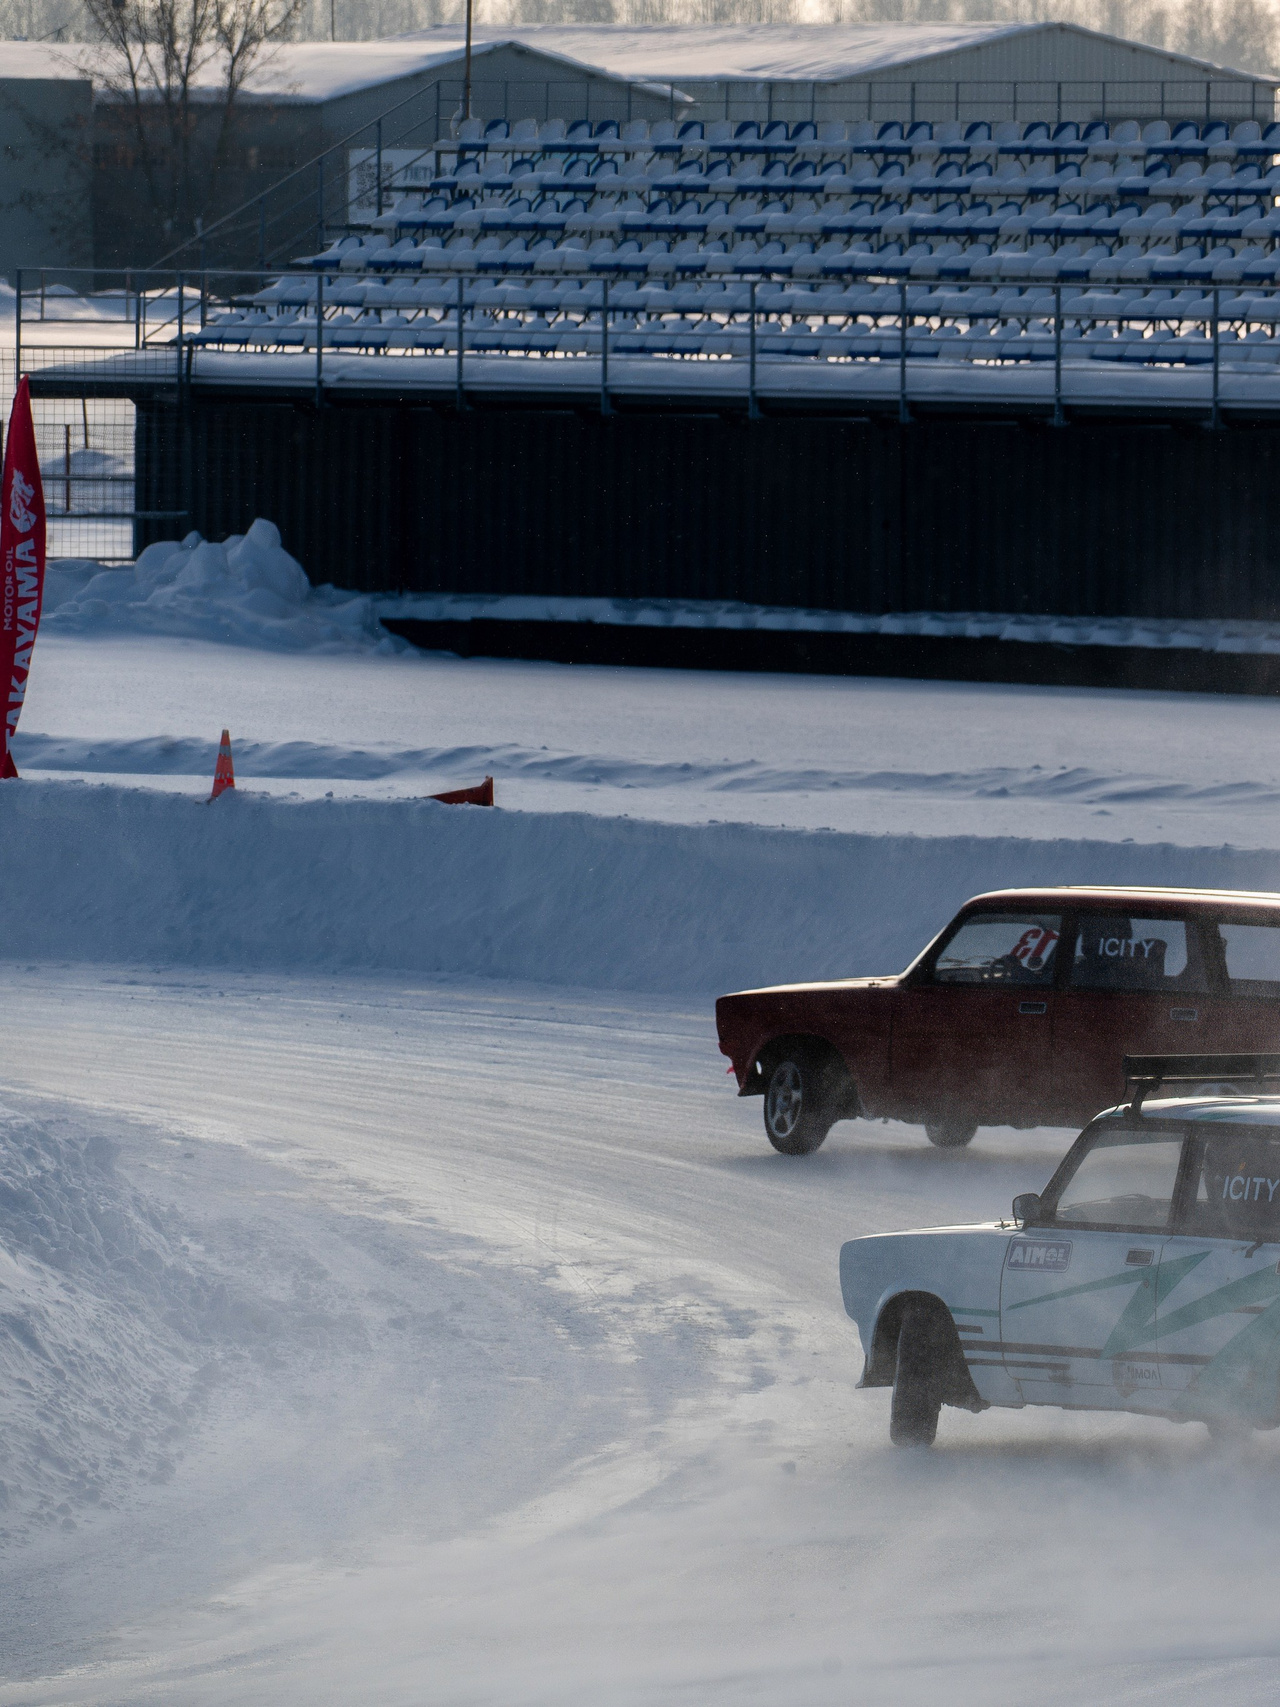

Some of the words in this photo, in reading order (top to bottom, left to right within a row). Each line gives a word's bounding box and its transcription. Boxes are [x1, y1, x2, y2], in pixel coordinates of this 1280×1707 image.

[5, 546, 14, 573] OIL
[3, 574, 15, 631] MOTOR
[5, 537, 39, 755] TAKAYAMA
[1098, 937, 1156, 959] ICITY
[1222, 1175, 1280, 1202] ICITY
[1009, 1246, 1067, 1265] AIMOL
